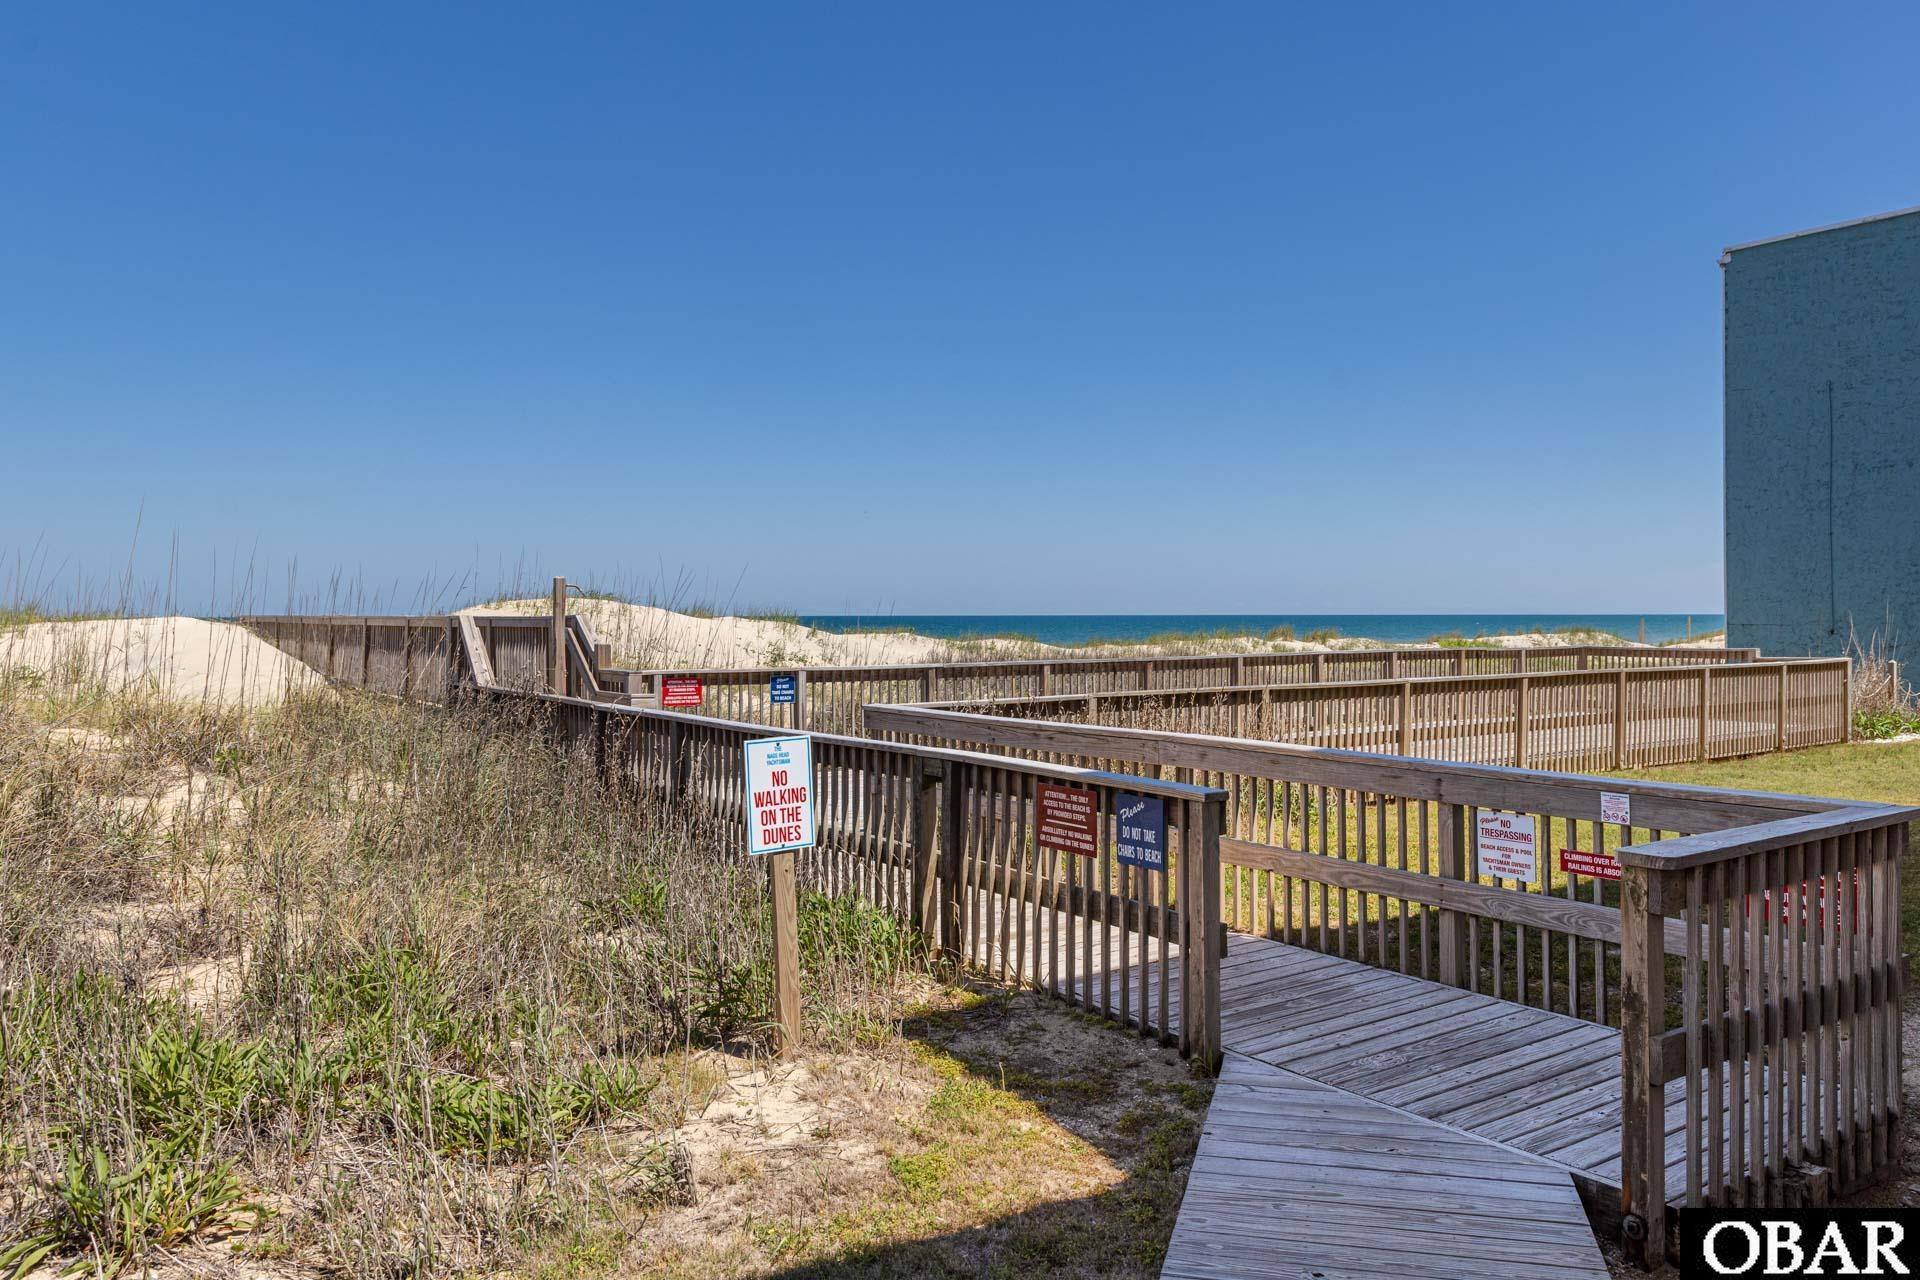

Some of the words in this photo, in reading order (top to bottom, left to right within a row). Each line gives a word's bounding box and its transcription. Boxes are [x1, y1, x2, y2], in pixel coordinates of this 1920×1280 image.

[772, 770, 788, 787] NO
[754, 786, 807, 808] WALKING
[1072, 804, 1086, 812] BEACH
[1120, 802, 1144, 822] Please
[760, 808, 777, 826] ON
[780, 806, 802, 824] THE
[1500, 820, 1511, 828] NO
[763, 824, 802, 845] DUNES
[1122, 826, 1130, 838] DO
[1132, 827, 1142, 840] NOT
[1144, 830, 1156, 844] TAKE
[1480, 828, 1532, 842] TRESPASSING
[1118, 844, 1135, 858] CHAIRS
[1136, 846, 1144, 860] TO
[1144, 848, 1162, 864] BEACH
[1496, 846, 1514, 854] ACCESS
[1483, 857, 1510, 866] YACHTSMAN
[1511, 862, 1531, 870] OWNERS
[1564, 852, 1592, 863] CLIMBING
[1594, 857, 1610, 866] OVER
[1568, 862, 1594, 872] RAILINGS
